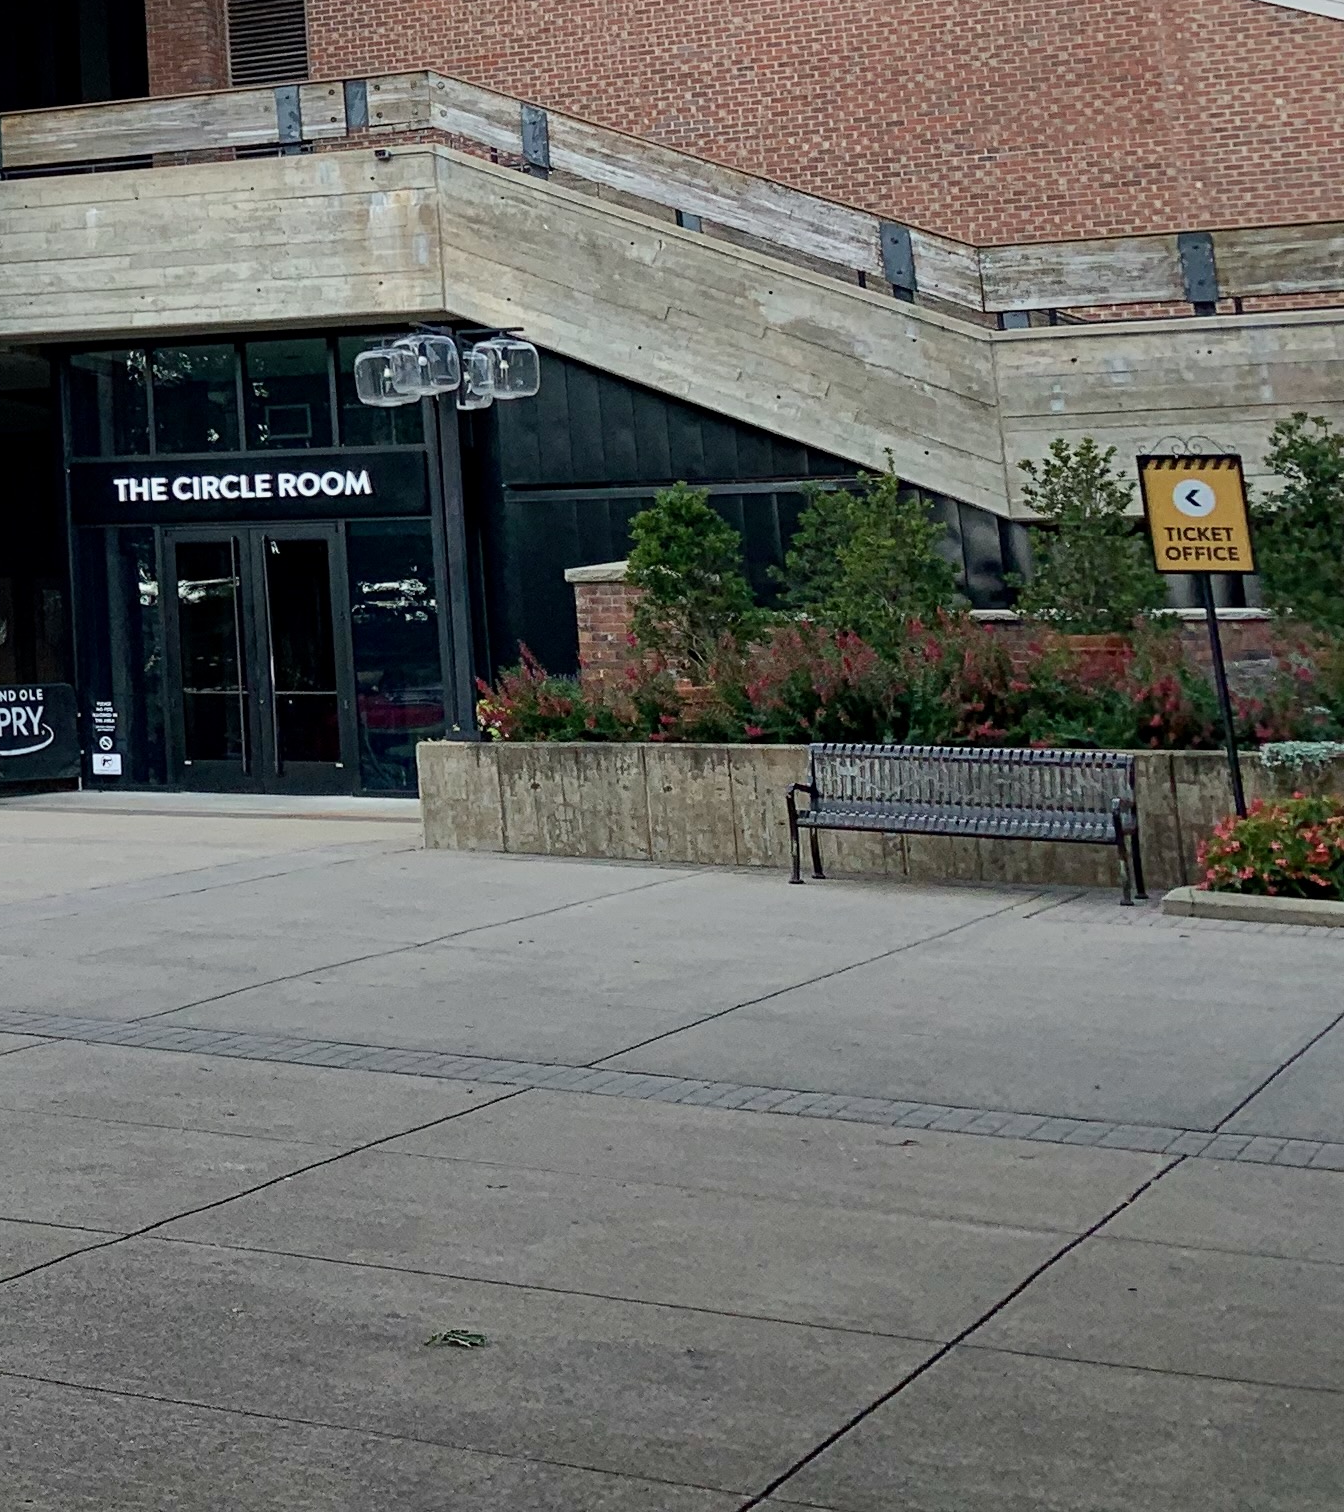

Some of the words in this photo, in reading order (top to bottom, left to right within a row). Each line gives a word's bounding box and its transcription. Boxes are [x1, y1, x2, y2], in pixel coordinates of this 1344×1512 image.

[113, 477, 169, 502] THE
[172, 473, 273, 501] CIRCLE
[278, 470, 373, 497] ROOM
[1164, 526, 1234, 542] TICKET
[1165, 546, 1240, 561] OFFICE
[19, 689, 44, 701] OLE
